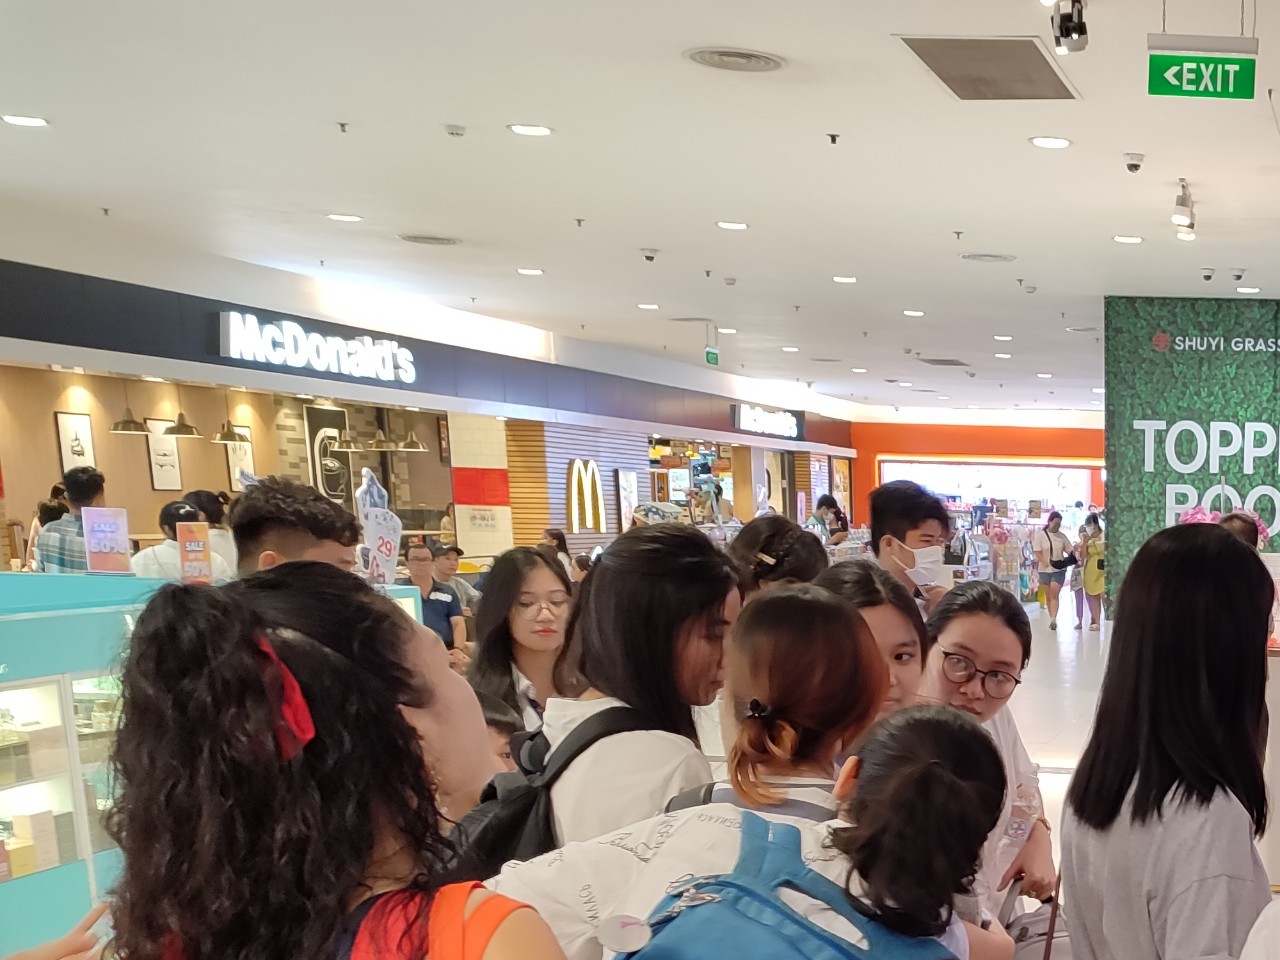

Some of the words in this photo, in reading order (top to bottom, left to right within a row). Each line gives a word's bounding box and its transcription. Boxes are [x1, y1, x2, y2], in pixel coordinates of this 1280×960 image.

[1182, 62, 1240, 93] EXIT
[226, 310, 417, 384] McDonald's
[1174, 336, 1224, 352] SHUYI
[185, 541, 204, 551] SALE
